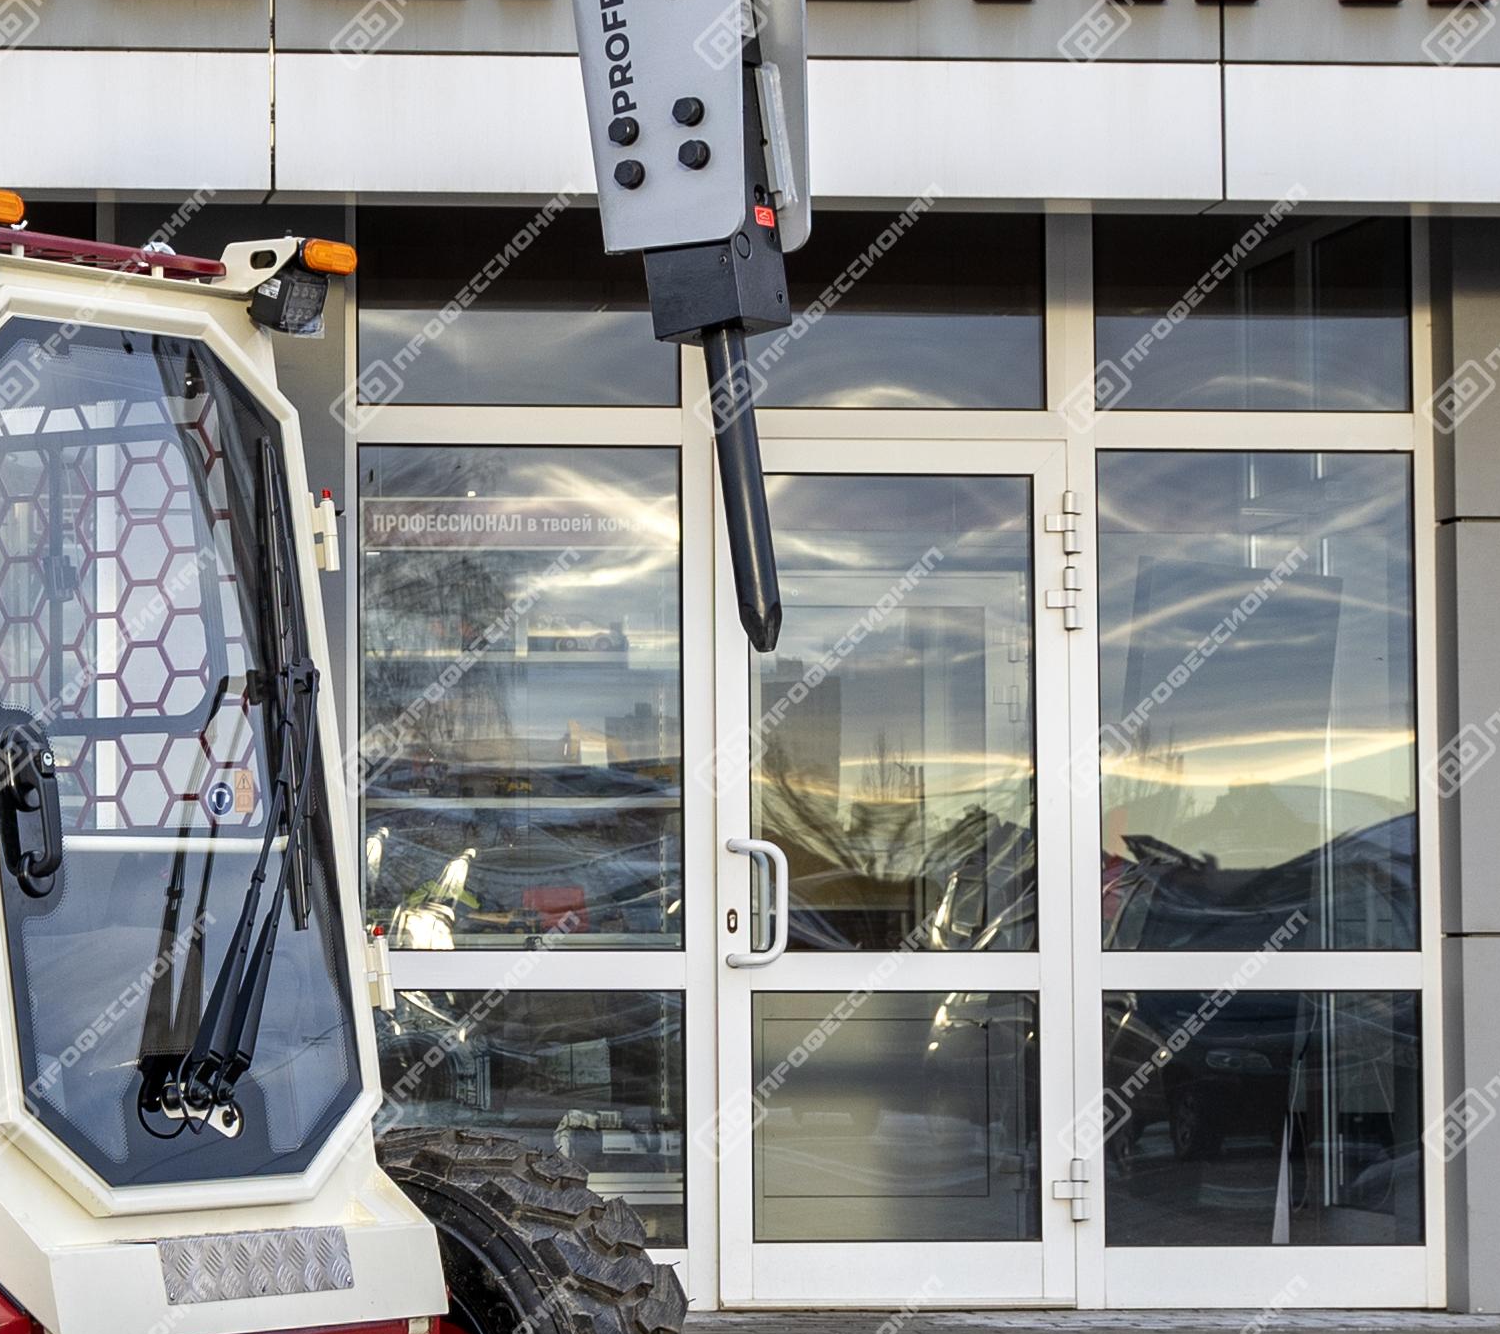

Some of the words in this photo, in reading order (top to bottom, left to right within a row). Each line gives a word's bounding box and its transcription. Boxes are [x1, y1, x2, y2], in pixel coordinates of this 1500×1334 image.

[372, 513, 523, 533] ПРОФЕССИОНАЛ
[527, 518, 538, 533] в
[541, 513, 593, 533] твоей
